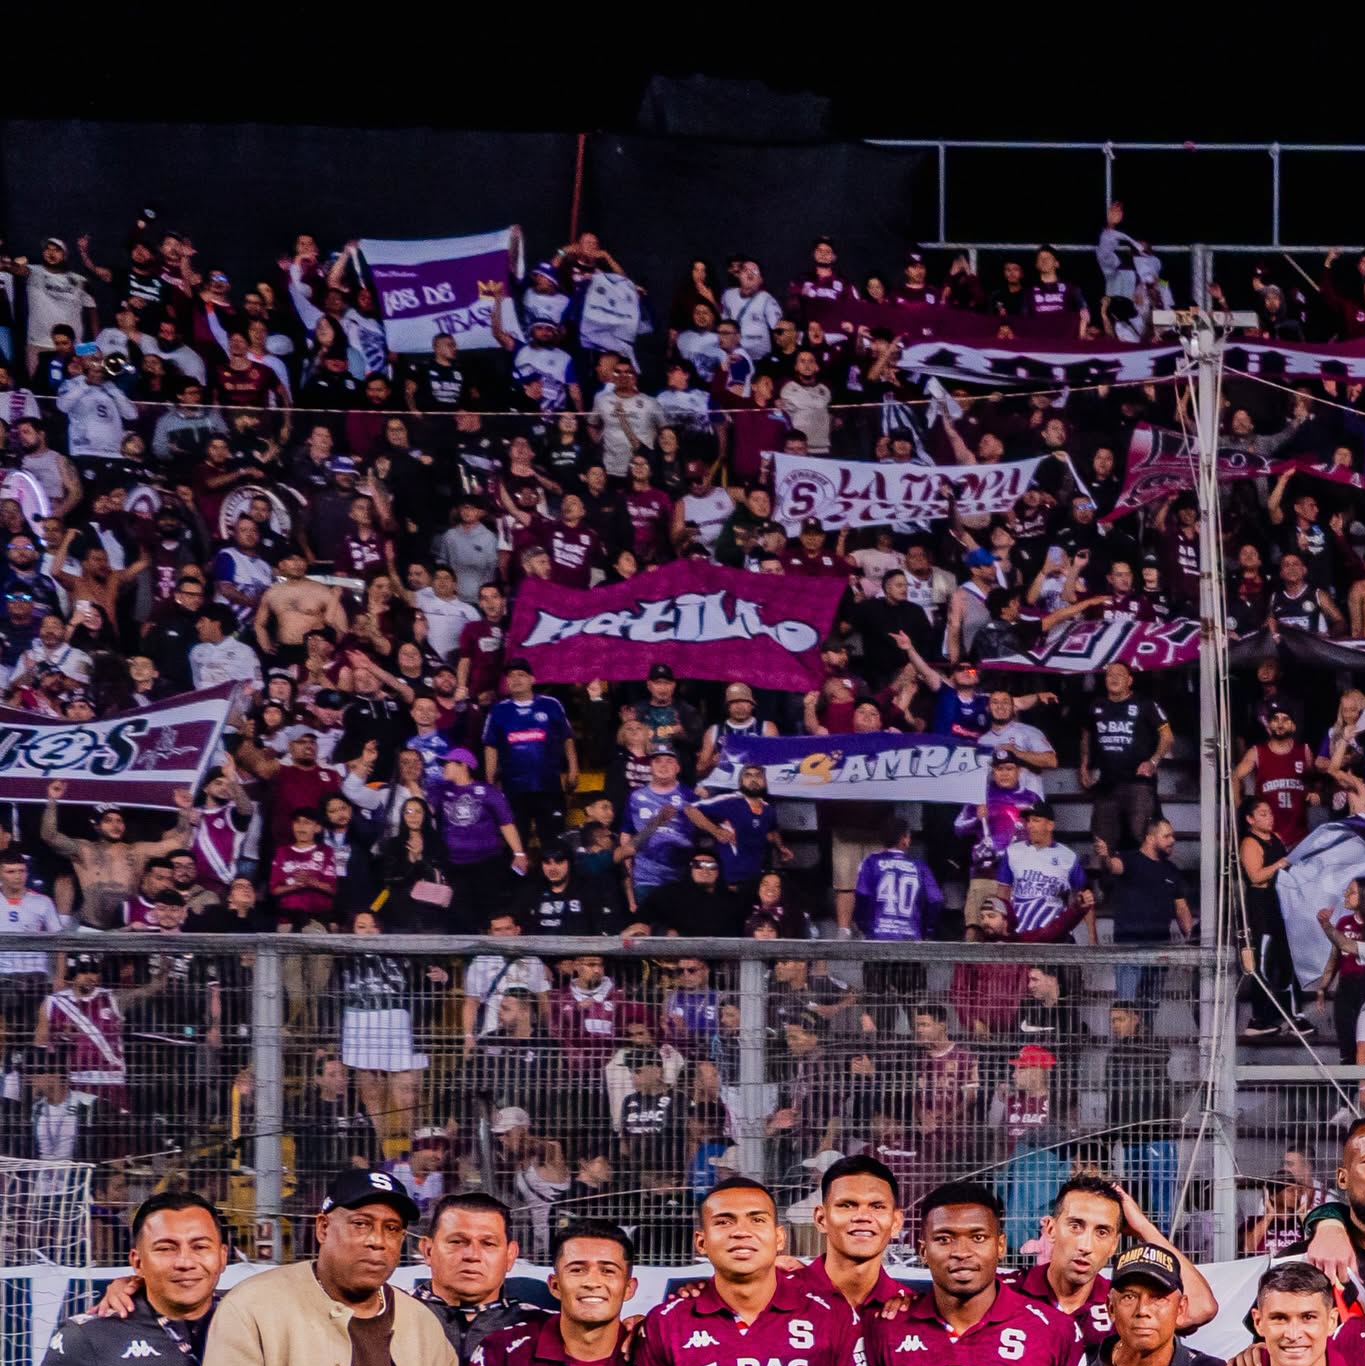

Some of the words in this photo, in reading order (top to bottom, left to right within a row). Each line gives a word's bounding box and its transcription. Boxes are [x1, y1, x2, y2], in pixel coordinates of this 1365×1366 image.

[1108, 721, 1134, 733] BAC
[876, 872, 920, 917] 40
[369, 1172, 393, 1191] S
[788, 1319, 815, 1349] S
[998, 1327, 1027, 1360] S
